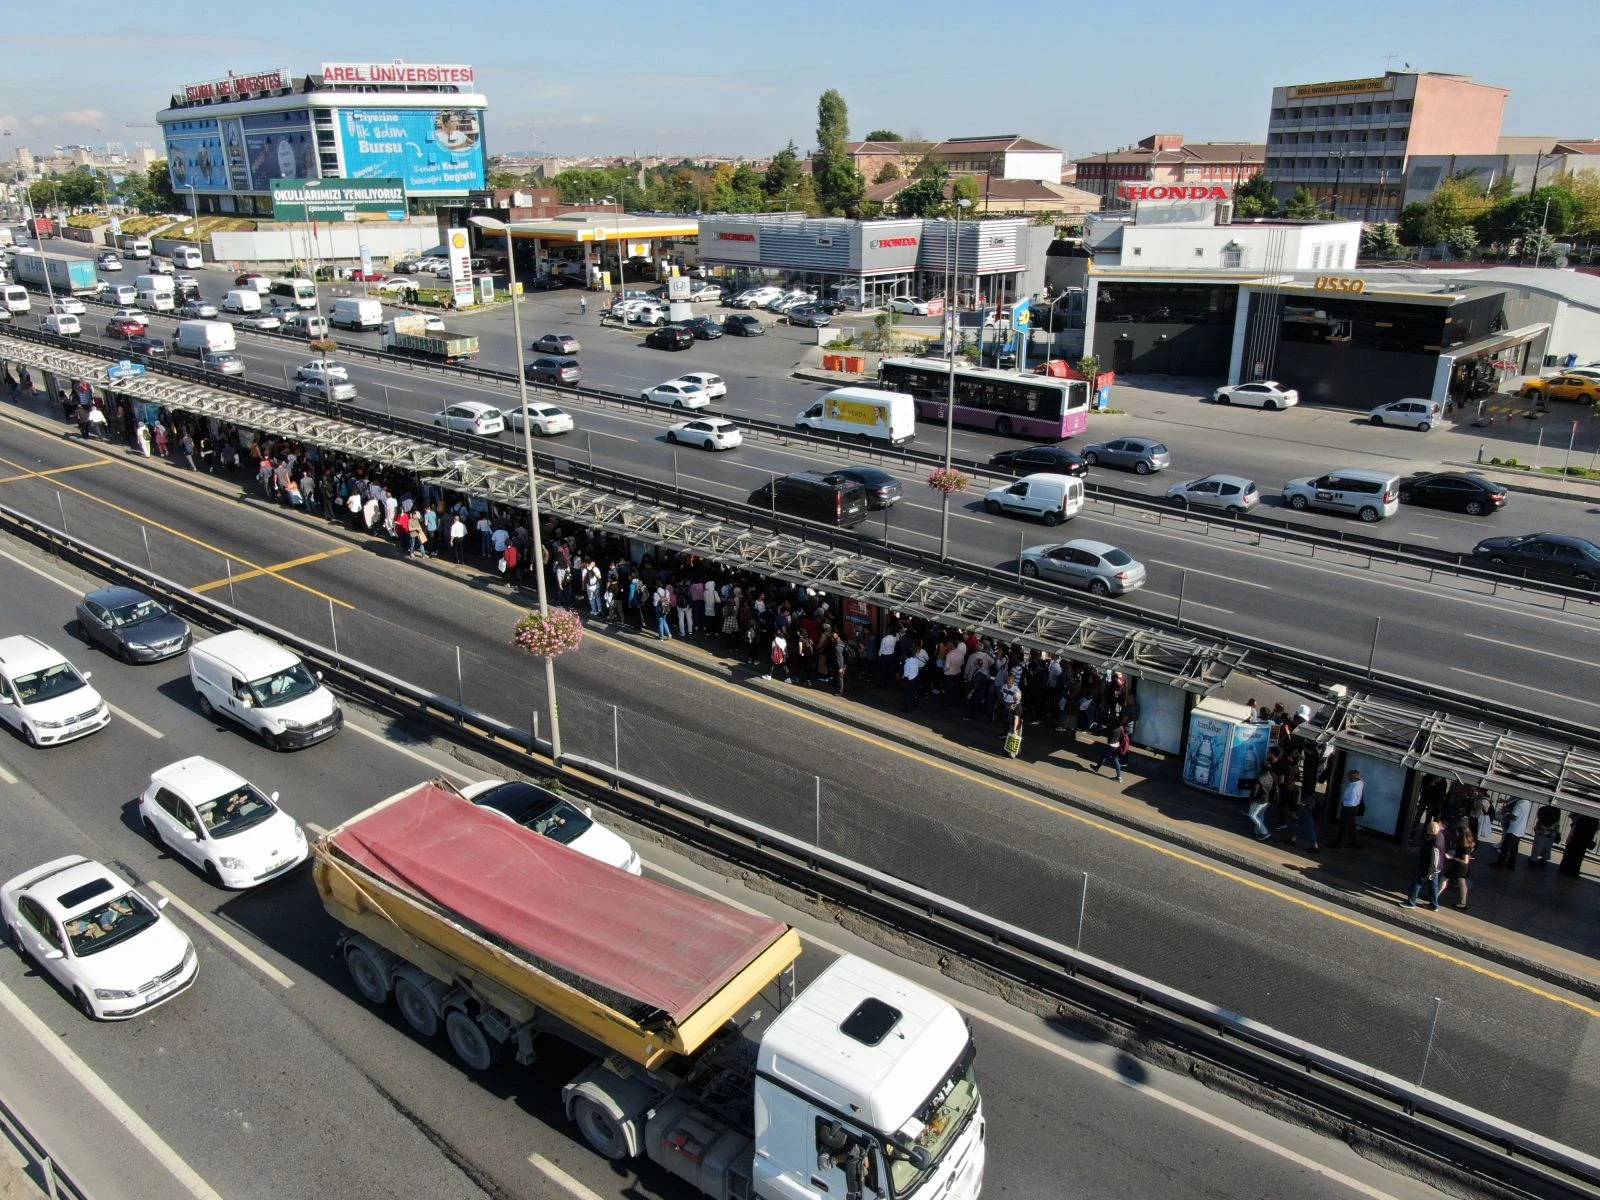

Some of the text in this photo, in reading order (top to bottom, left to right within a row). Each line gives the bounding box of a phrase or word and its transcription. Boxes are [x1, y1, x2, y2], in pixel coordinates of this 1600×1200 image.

[323, 65, 474, 82] AREL ÜNİVERSİTESİ
[358, 140, 403, 153] Bursu
[273, 189, 341, 201] OKULLARIMIZI
[1127, 185, 1229, 200] HONDA
[719, 232, 756, 242] HONDA
[878, 237, 917, 248] HONDA
